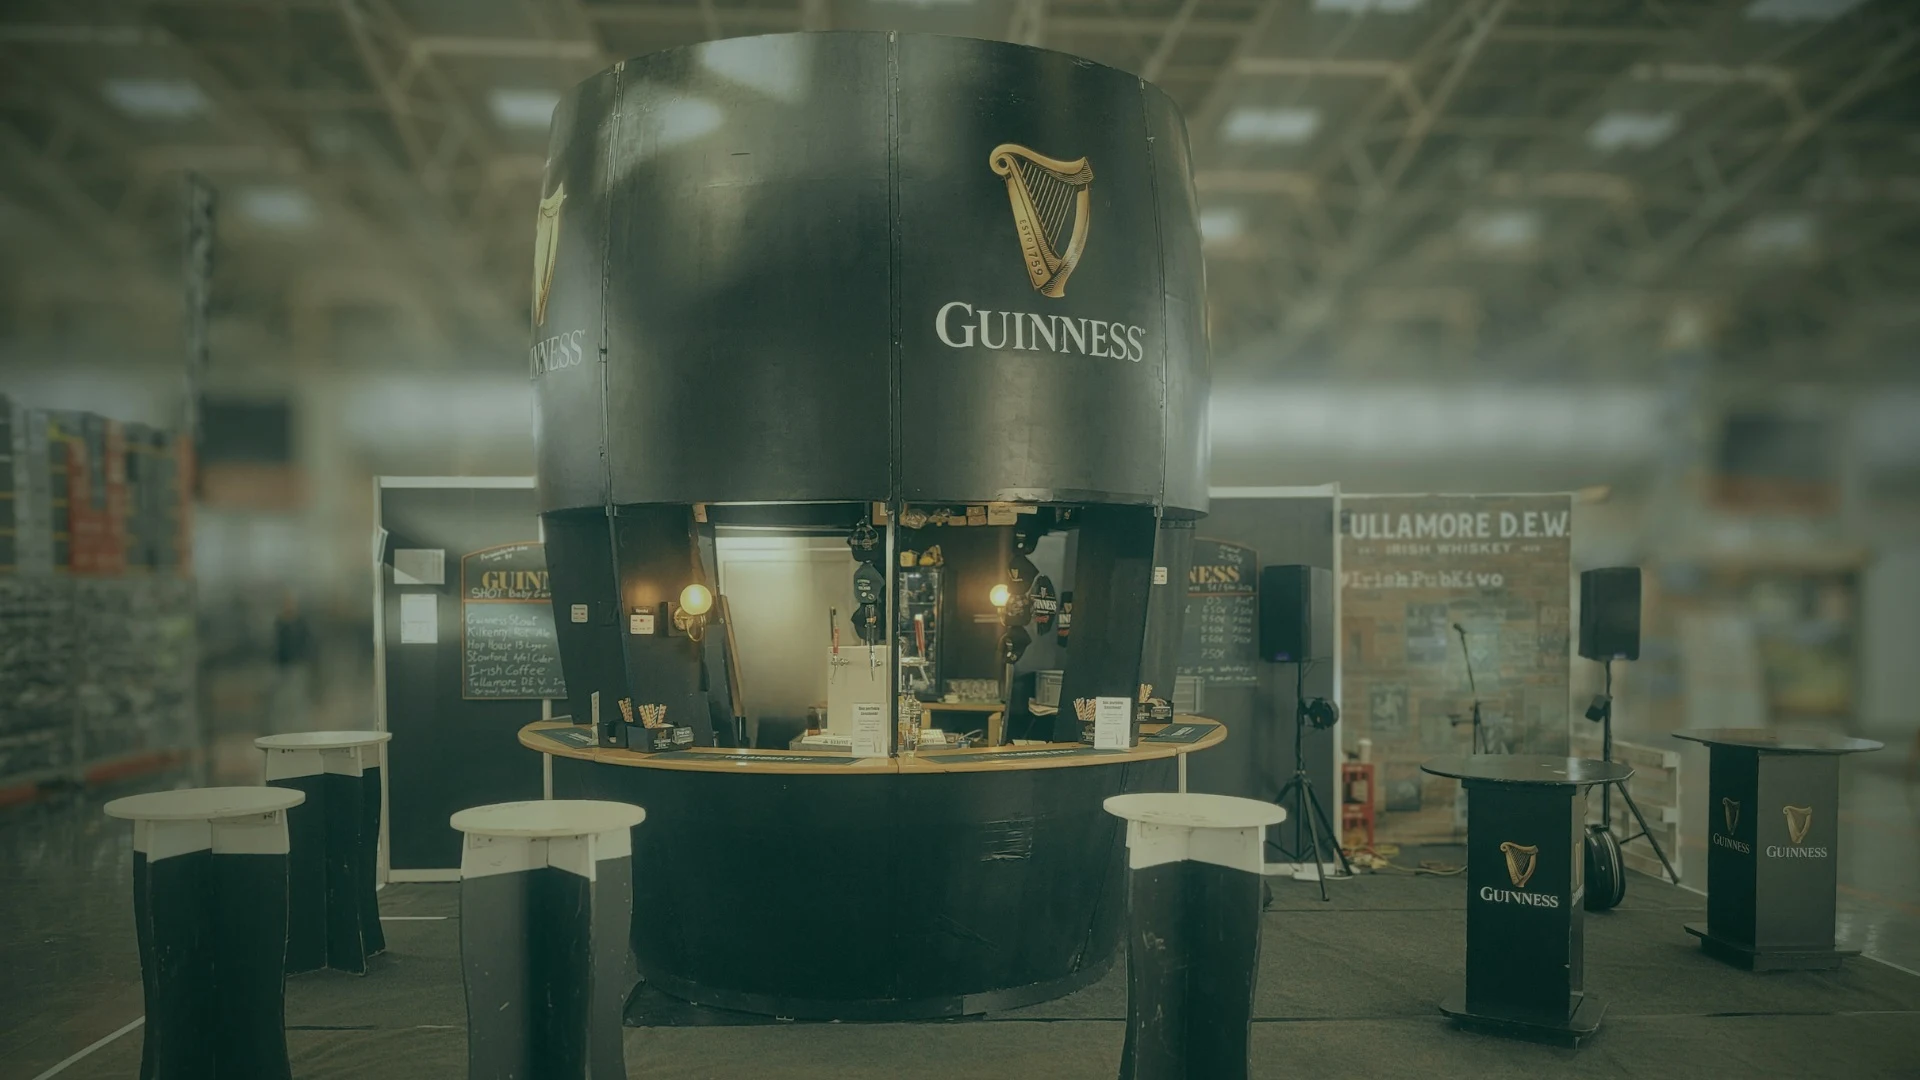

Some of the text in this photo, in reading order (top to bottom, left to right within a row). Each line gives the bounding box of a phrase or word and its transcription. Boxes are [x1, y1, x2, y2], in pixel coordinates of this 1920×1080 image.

[1026, 246, 1044, 276] 1759
[935, 301, 1145, 363] GUINNESS
[530, 329, 583, 379] INNESS
[1348, 511, 1570, 539] ULLAMORE D.E.W.
[1386, 543, 1431, 556] IRISH
[1437, 542, 1512, 555] WHISKEY
[508, 588, 532, 601] Baby
[467, 639, 486, 651] Hop
[468, 663, 546, 677] Irish Coffee
[469, 677, 516, 687] Tullamore
[1713, 832, 1750, 855] GUINNESS
[1766, 845, 1828, 858] GUINNESS
[1480, 886, 1559, 908] GUINNESS
